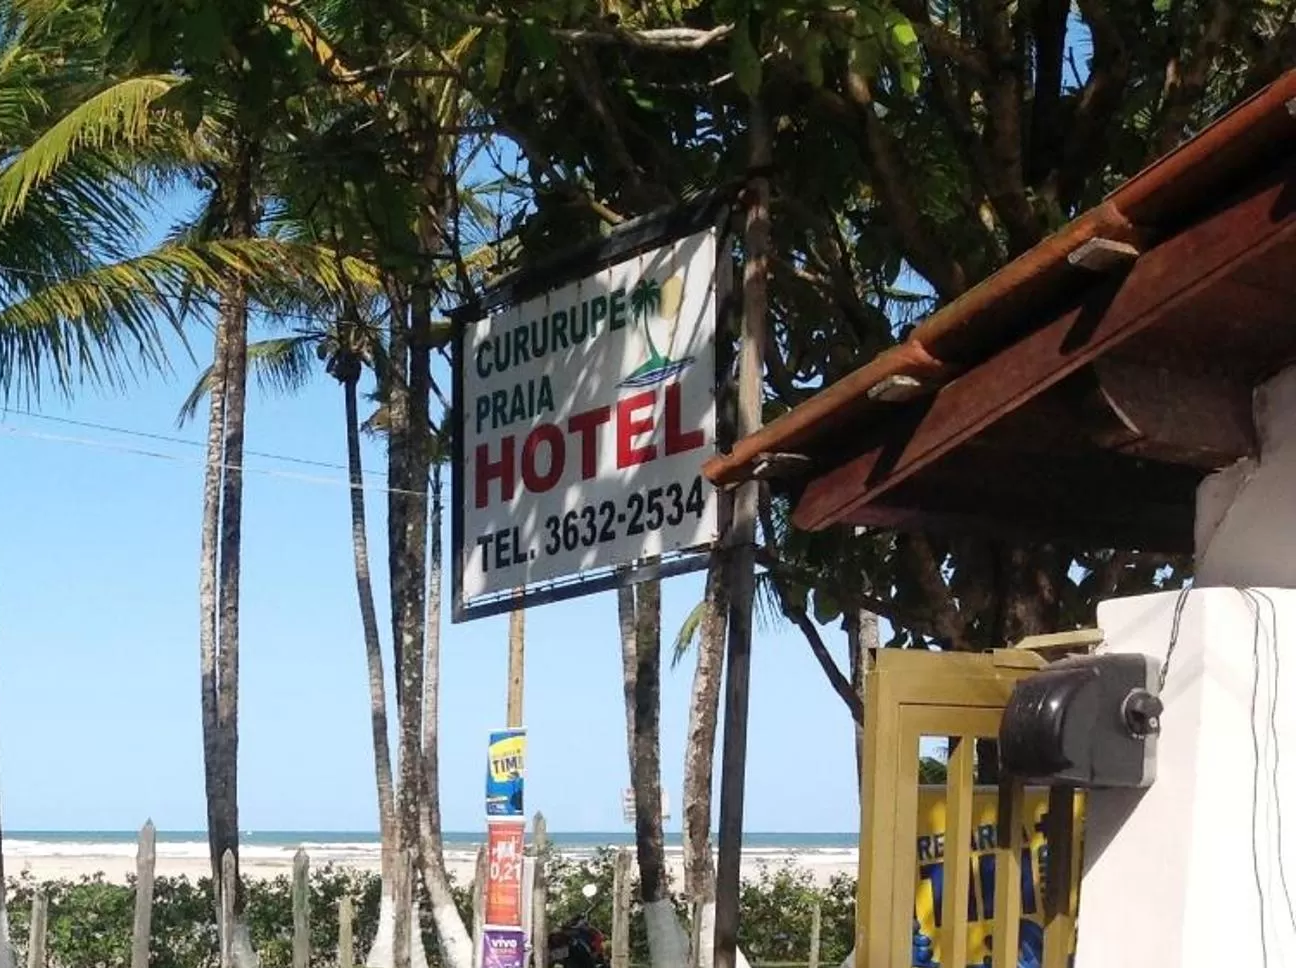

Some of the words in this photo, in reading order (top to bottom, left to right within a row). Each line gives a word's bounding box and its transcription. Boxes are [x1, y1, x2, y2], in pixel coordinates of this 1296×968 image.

[476, 290, 627, 379] CURURUPE
[475, 381, 705, 509] HOTEL
[476, 374, 555, 434] PRAIA
[476, 526, 535, 572] TEL.
[545, 475, 704, 557] 3632-2534
